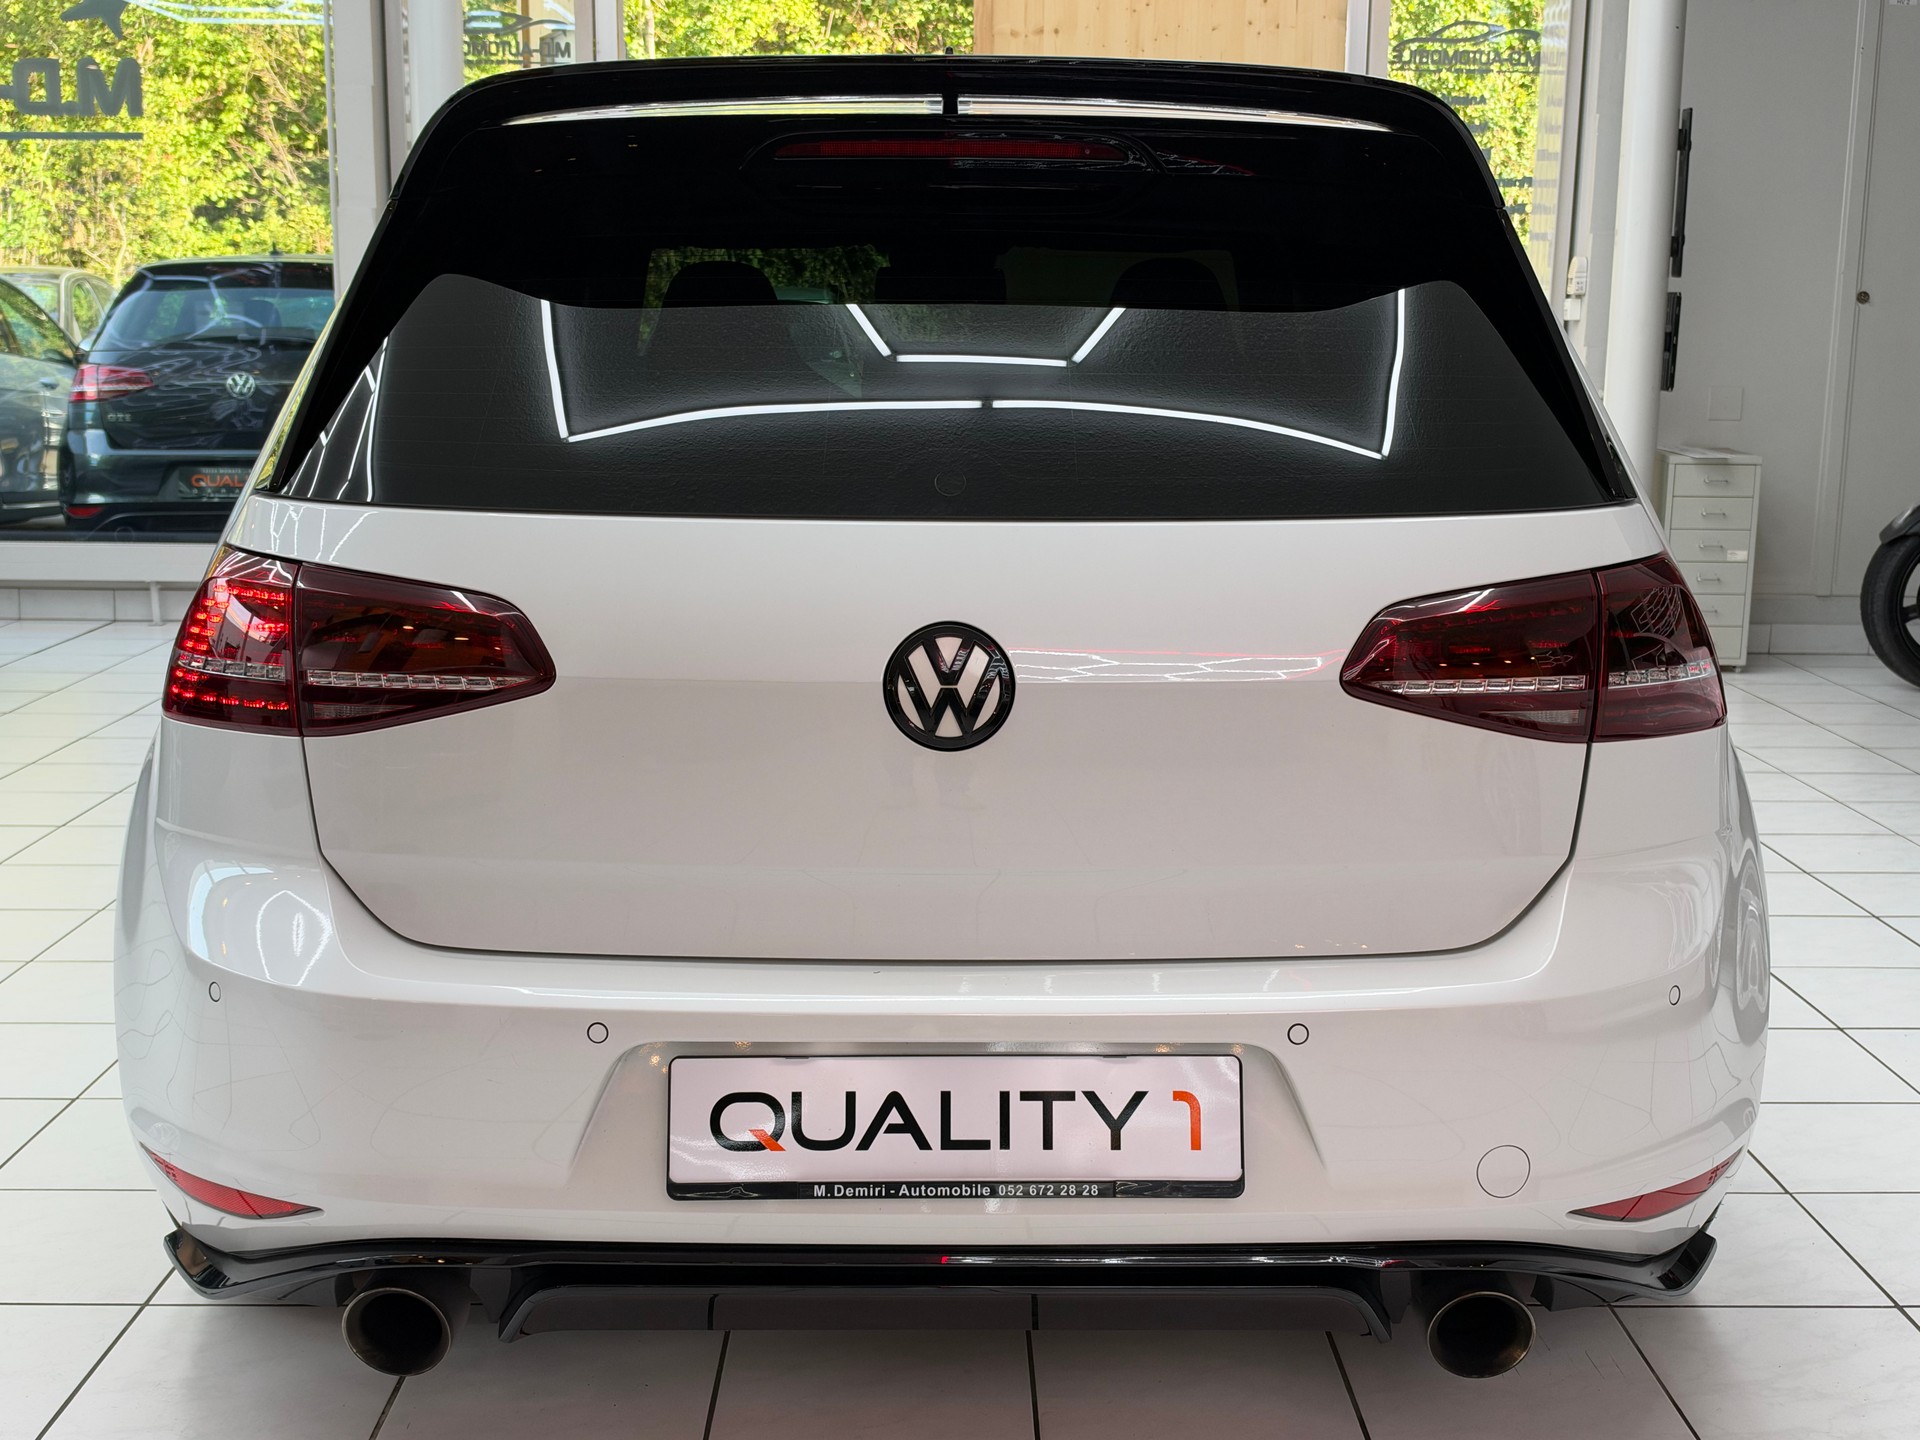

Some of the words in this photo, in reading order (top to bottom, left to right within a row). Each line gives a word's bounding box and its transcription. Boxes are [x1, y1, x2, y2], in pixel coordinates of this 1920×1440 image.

[710, 1091, 1149, 1151] QUALITY
[1172, 1090, 1202, 1151] 1
[898, 1184, 991, 1197] Automobile
[998, 1184, 1024, 1196] 052
[1029, 1184, 1055, 1196] 672
[1060, 1184, 1077, 1196] 28
[1082, 1184, 1099, 1196] 28
